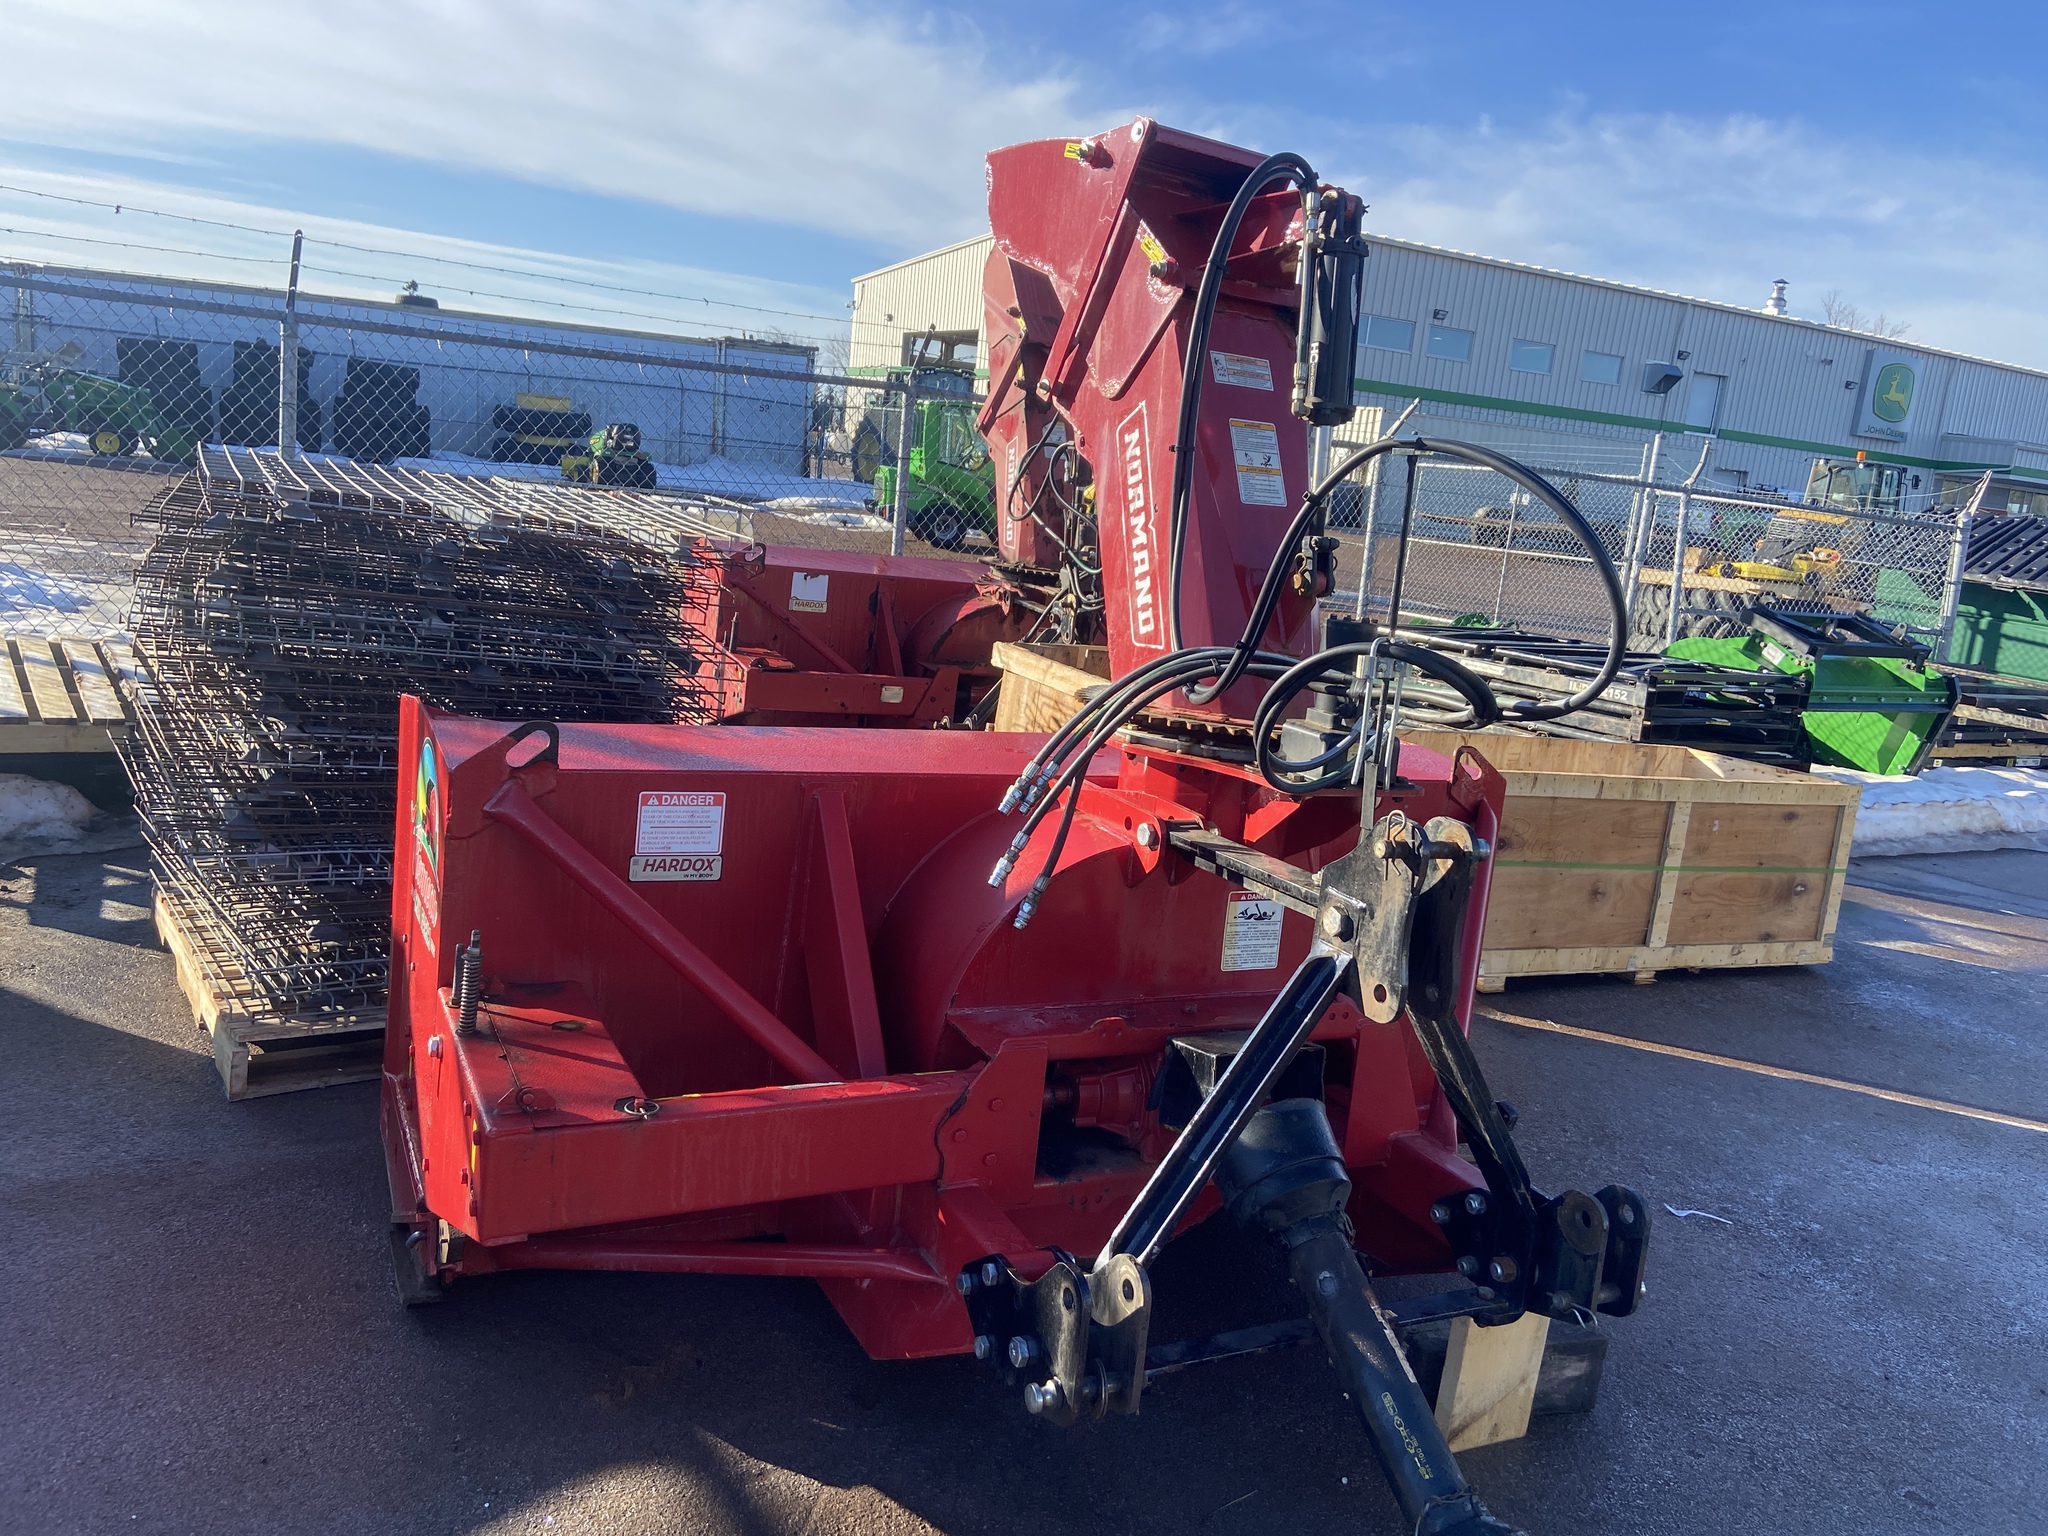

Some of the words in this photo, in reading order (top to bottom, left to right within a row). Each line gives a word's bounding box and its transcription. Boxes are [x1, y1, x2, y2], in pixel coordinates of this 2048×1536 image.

[1864, 424, 1885, 436] JOHN
[1886, 428, 1904, 438] DEERE
[1124, 428, 1155, 636] NORMAND
[794, 600, 825, 608] HARDOX
[662, 795, 714, 806] DANGER
[642, 858, 716, 872] HARDOX
